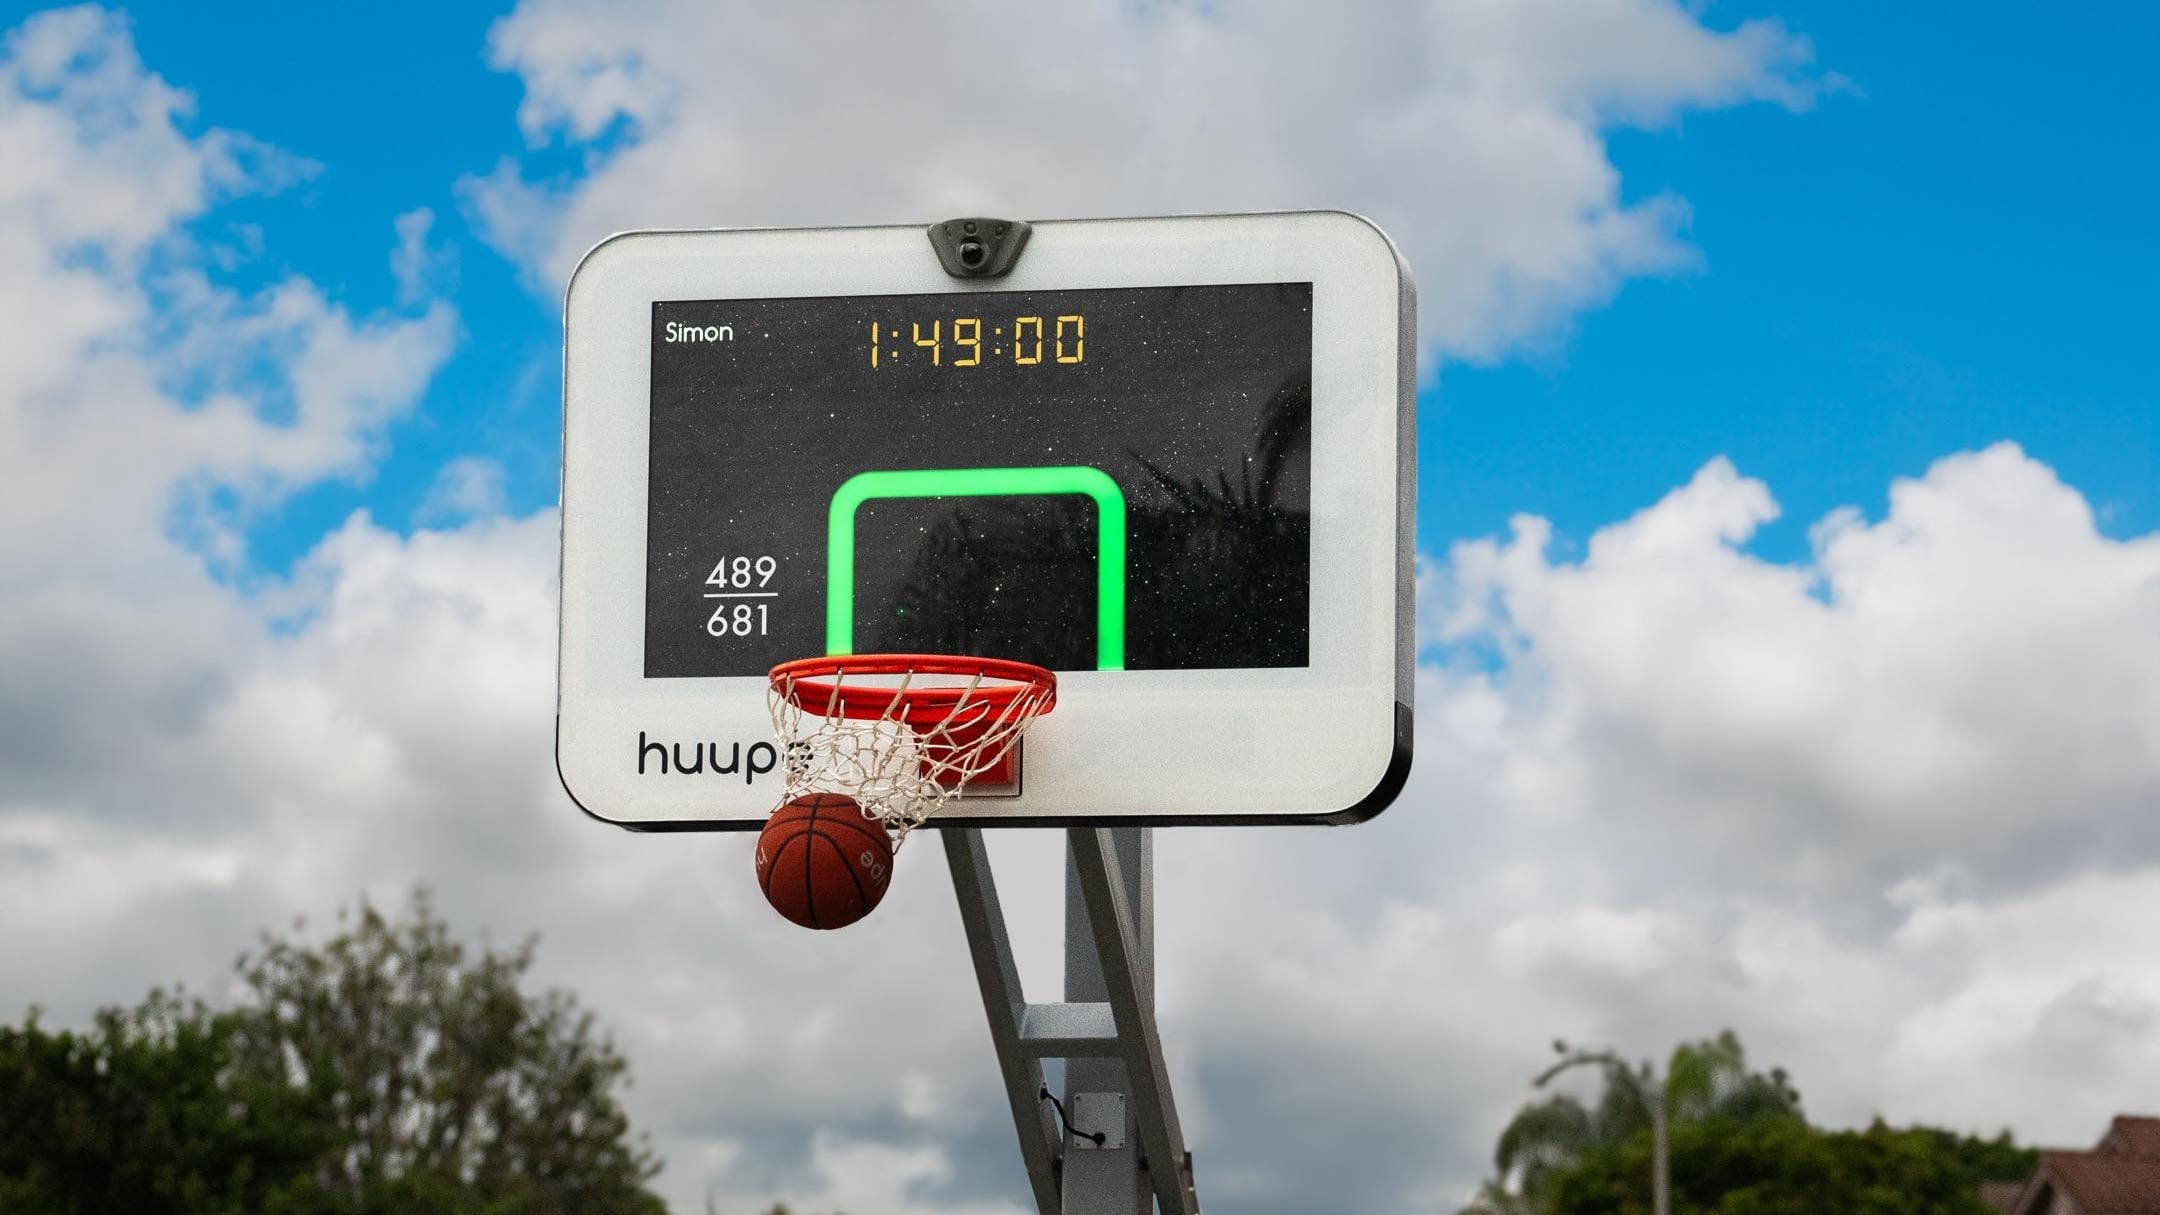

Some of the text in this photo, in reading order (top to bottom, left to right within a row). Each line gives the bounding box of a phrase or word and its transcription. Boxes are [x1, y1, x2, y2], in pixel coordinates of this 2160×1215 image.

[665, 321, 733, 343] Simon
[871, 315, 1084, 369] 1:49:00
[704, 556, 777, 588] 489
[707, 604, 767, 637] 681
